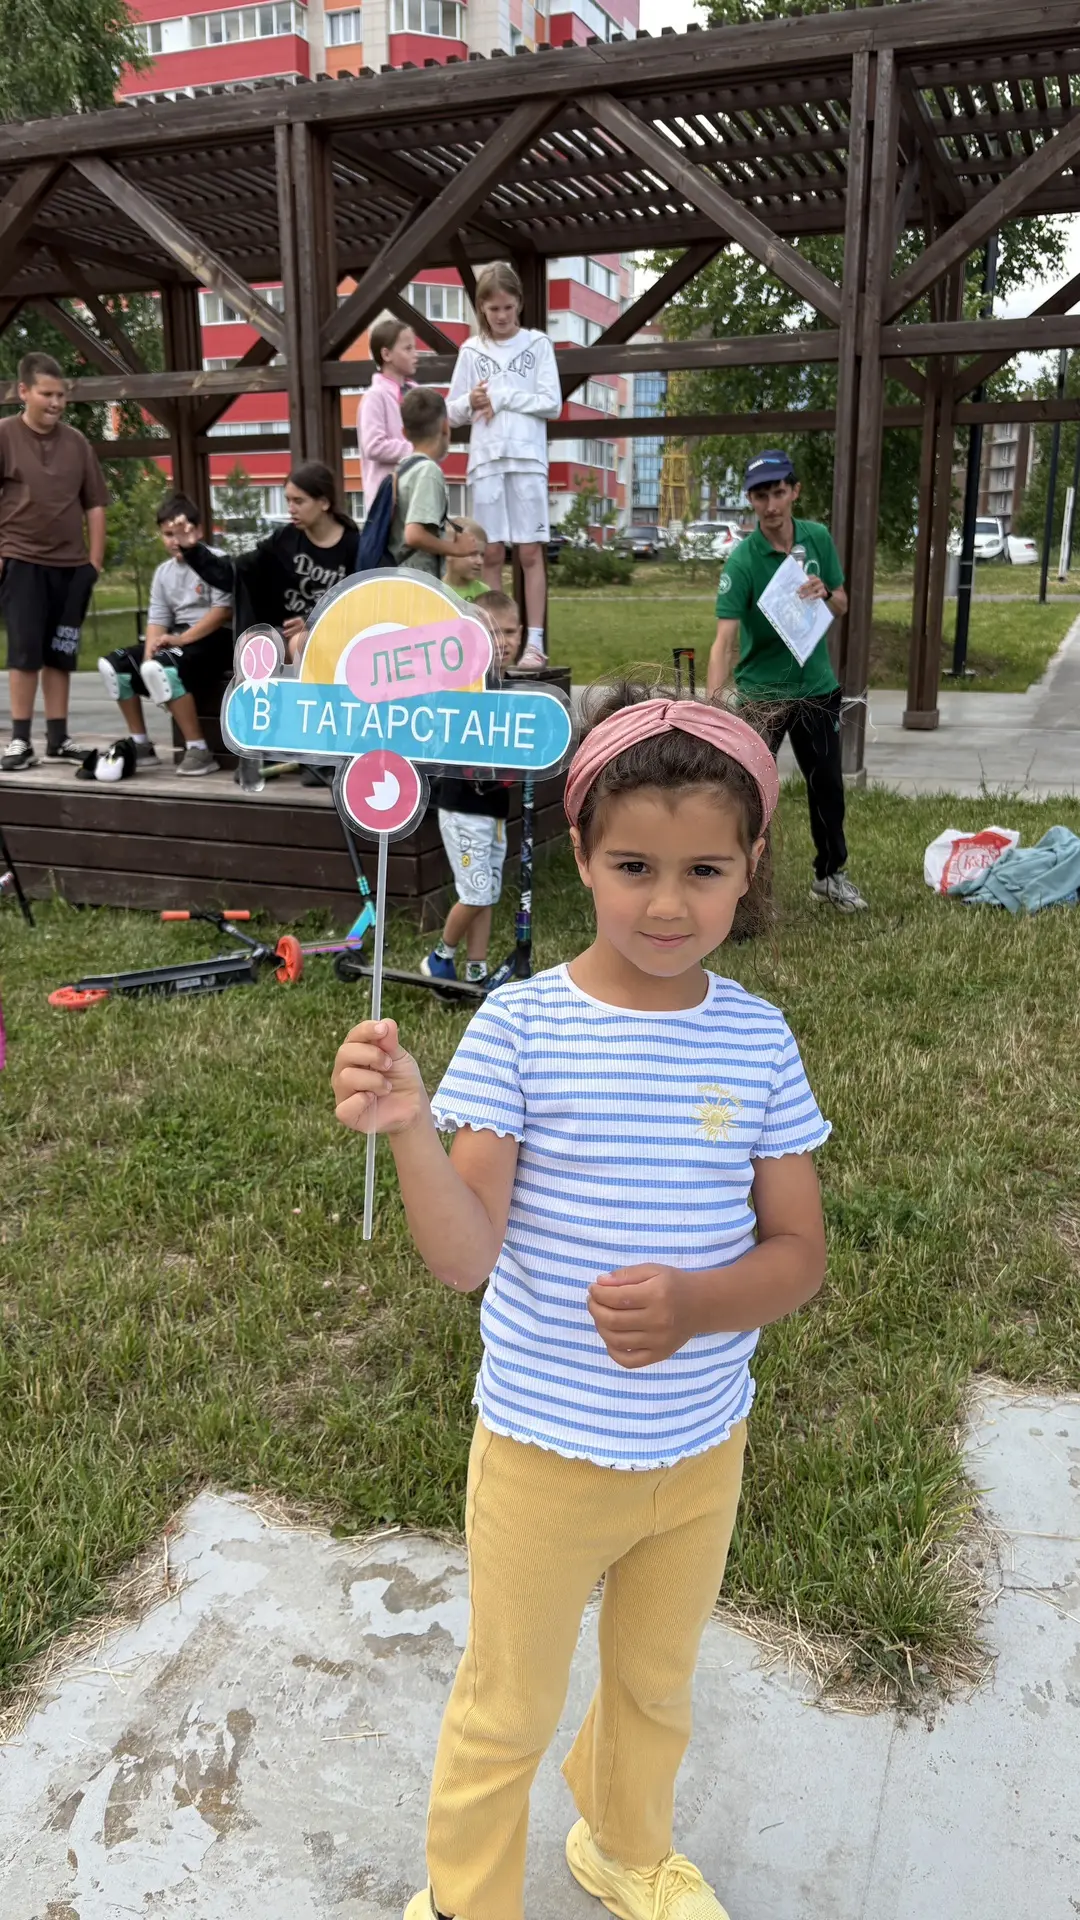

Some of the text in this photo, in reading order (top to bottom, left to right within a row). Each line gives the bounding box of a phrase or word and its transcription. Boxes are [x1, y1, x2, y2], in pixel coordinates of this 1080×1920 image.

[370, 636, 464, 687] ЛЕТО
[252, 698, 536, 749] В ТАТАРСТАНЕ
